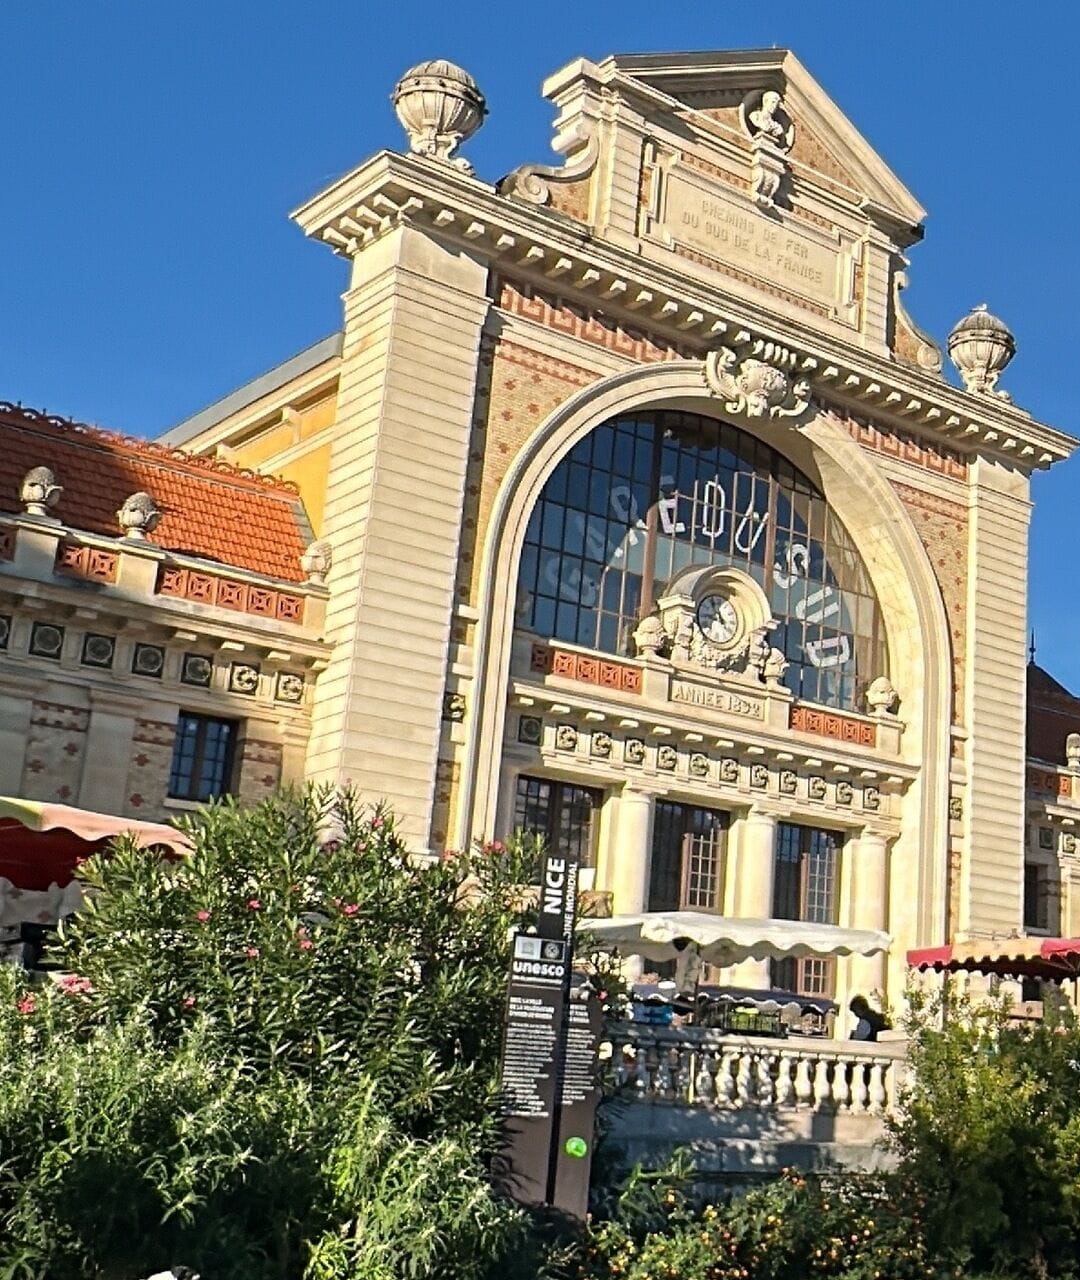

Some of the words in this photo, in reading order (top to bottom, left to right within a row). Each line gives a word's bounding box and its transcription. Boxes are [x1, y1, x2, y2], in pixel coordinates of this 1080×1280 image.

[682, 211, 699, 229] DU
[734, 233, 750, 252] DE
[755, 244, 771, 262] LA
[777, 254, 823, 283] FRANCE
[786, 239, 809, 259] FER
[545, 474, 686, 608] GARE
[702, 480, 769, 554] DU
[773, 543, 850, 668] SUD
[543, 857, 565, 915] NICE
[565, 861, 578, 913] MONDIAL
[512, 961, 565, 977] unesco
